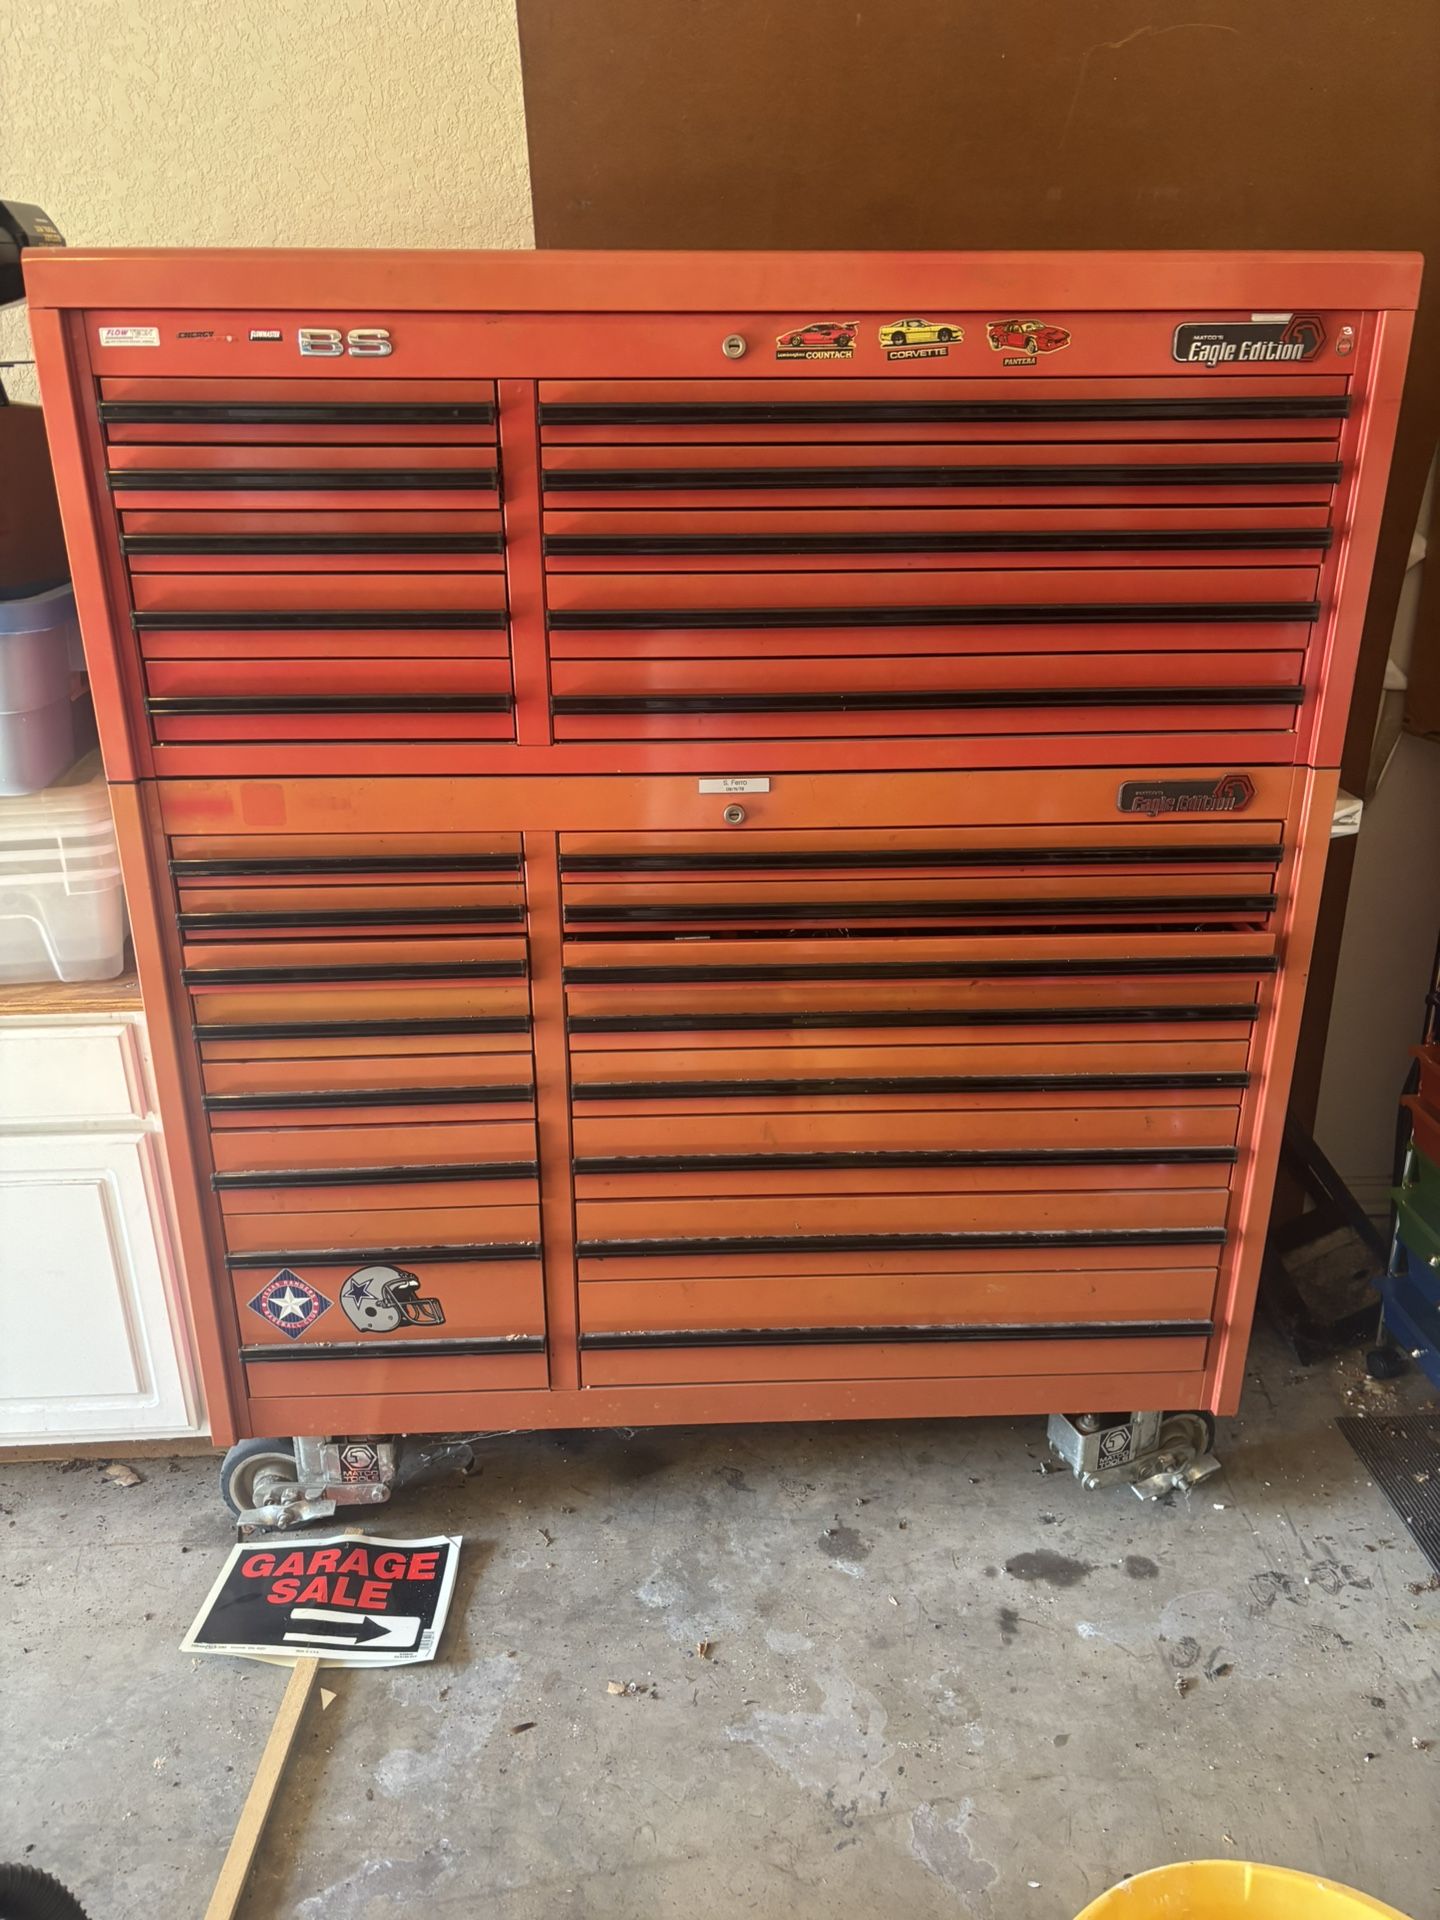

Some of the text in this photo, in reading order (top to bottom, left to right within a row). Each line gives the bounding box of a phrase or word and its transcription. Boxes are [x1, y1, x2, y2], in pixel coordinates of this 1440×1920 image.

[805, 350, 852, 359] COUNTACH
[889, 347, 947, 359] CORVETTE
[1188, 341, 1305, 367] Eagle Edition
[1131, 795, 1236, 817] Eagle Edition
[1099, 1450, 1129, 1464] MATCO
[241, 1548, 440, 1580] GARAGE
[266, 1576, 393, 1610] SALE
